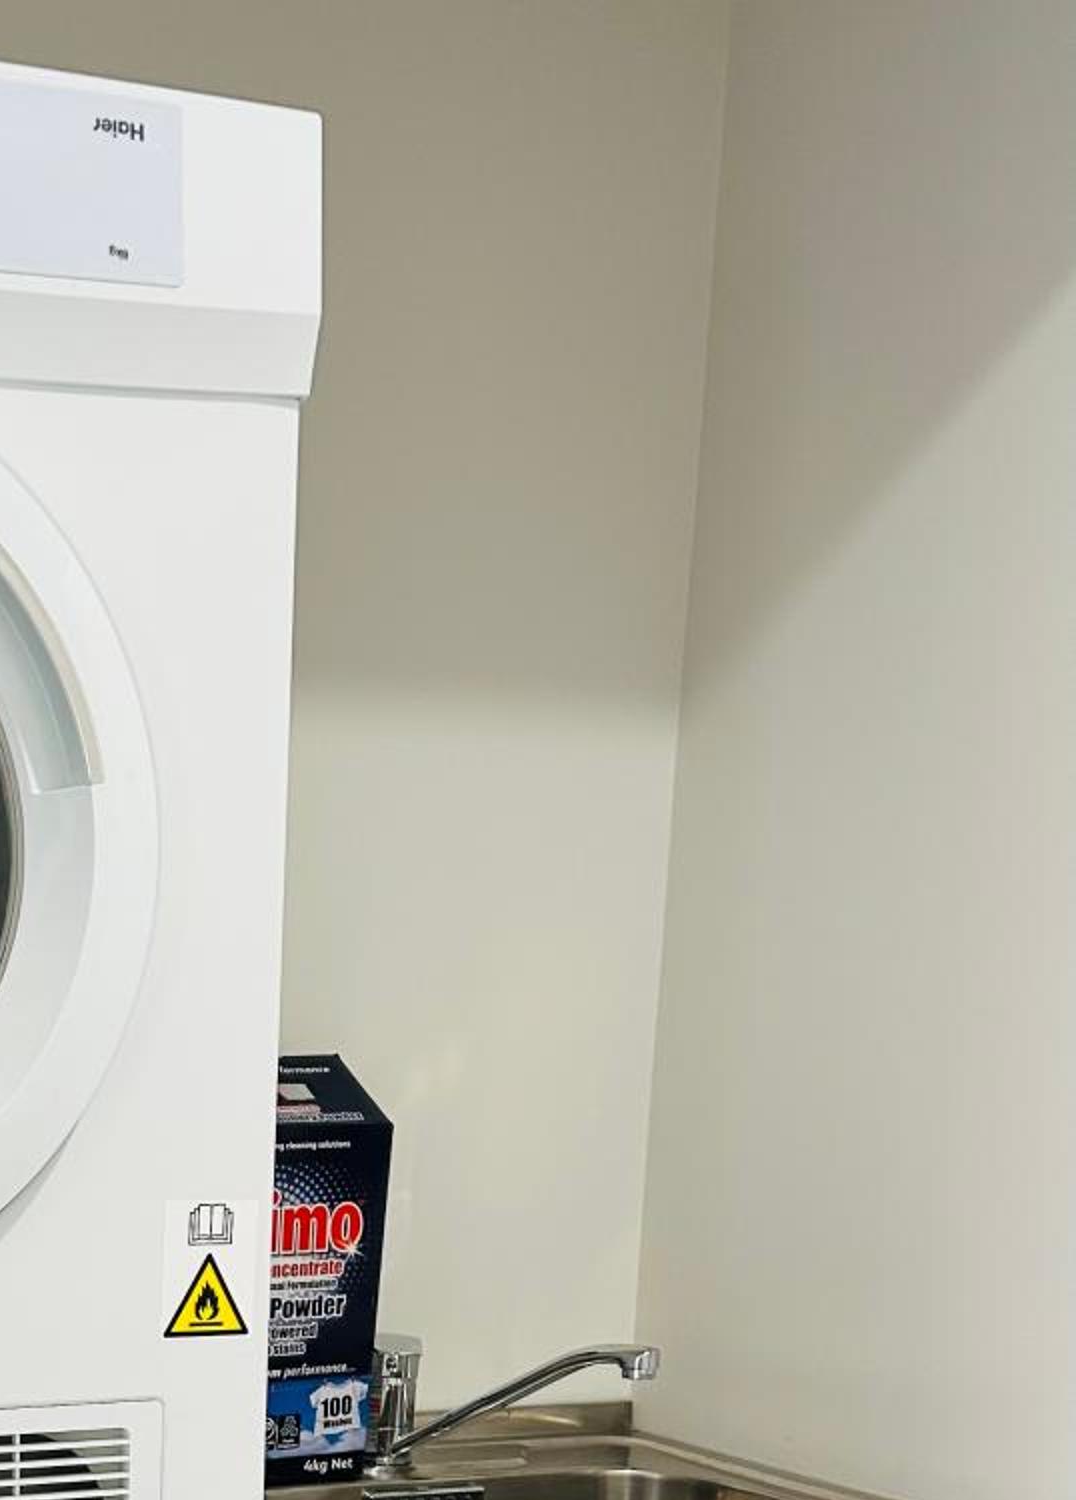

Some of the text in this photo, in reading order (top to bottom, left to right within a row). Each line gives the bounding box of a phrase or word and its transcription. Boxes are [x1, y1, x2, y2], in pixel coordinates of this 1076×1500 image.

[93, 117, 145, 142] Haier
[285, 1141, 317, 1151] cleaning
[317, 1140, 351, 1150] solutions
[269, 1293, 347, 1320] Powder
[320, 1395, 353, 1419] 100
[303, 1457, 354, 1475] 4kg Net
